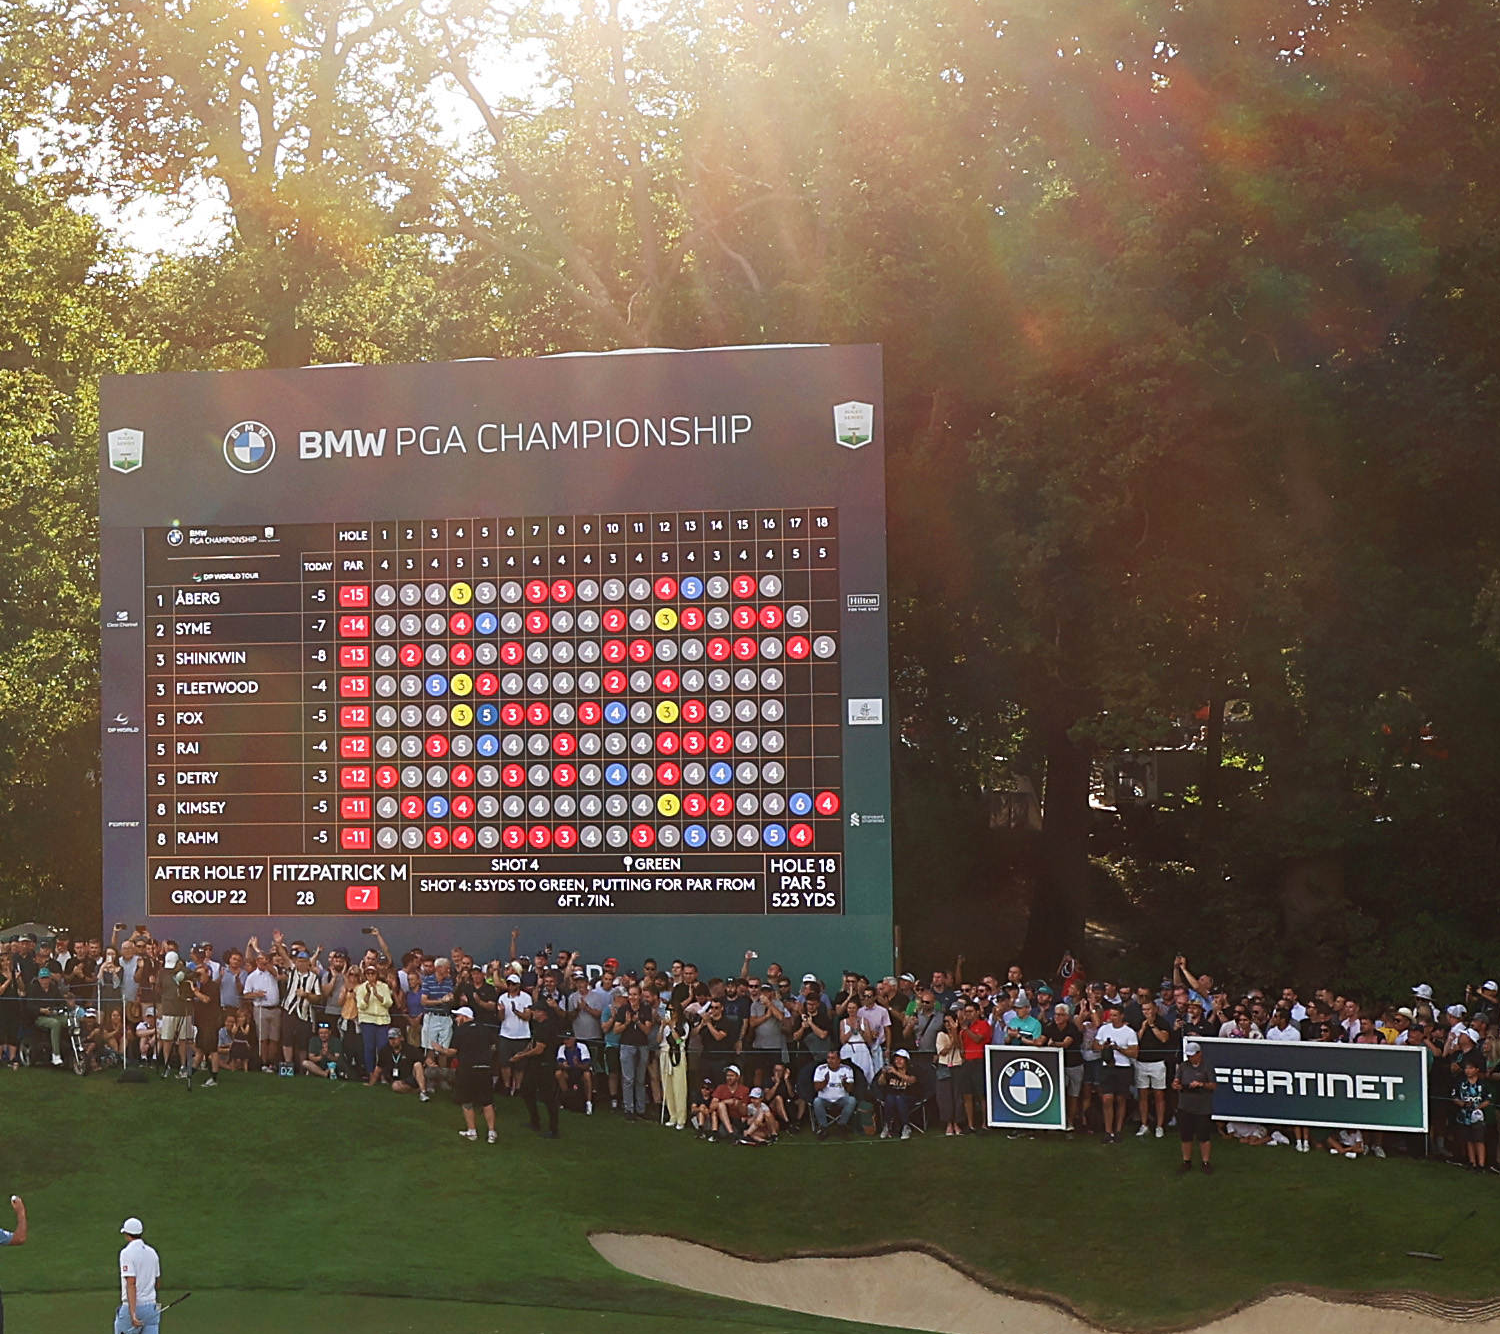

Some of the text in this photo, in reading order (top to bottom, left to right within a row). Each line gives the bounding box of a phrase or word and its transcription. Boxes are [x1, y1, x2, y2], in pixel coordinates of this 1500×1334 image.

[231, 424, 268, 439] BMW
[300, 414, 752, 460] BMW PGA CHAMPIONSHIP
[190, 530, 209, 539] BMW
[340, 517, 828, 541] HOLE 1 2 3 4 5 6 7 8 9 10 11 12 13 14 15 16 17 18
[304, 548, 826, 571] TODAY PAR 4 3 4 5 3 4 4 4 4 3 4 5 4 3 4 4 5 5
[158, 589, 363, 606] 1 ÅBERG -5 -15
[157, 619, 364, 636] 2 SYME -7 -14
[157, 649, 364, 666] 3 SHINKWIN -8 -13
[157, 679, 364, 696] 3 FLEETWOOD -4 -13
[157, 709, 364, 725] 5 FOX -5 -12
[158, 740, 364, 755] 5 RAI -4 -12
[158, 770, 365, 785] 5 DETRY -3 -12
[158, 801, 364, 815] 8 KIMSEY -5 -11
[158, 831, 364, 845] 8 RAHM -5 -11
[155, 866, 263, 879] AFTER HOLE 17
[274, 864, 406, 881] FITZPATRICK M
[492, 859, 539, 871] SHOT 4
[635, 858, 682, 873] GREEN
[771, 859, 835, 873] HOLE 18
[421, 878, 755, 892] SHOT 4: 53YDS TO GREEN, PUTTING FOR PAR FROM
[781, 876, 825, 889] PAR 5
[172, 890, 246, 903] GROUP 22
[297, 891, 314, 905] 28
[355, 890, 370, 903] -7
[558, 895, 614, 906] 6FT. 7IN.
[773, 893, 835, 907] 523 YDS
[280, 1067, 293, 1075] DZ
[1005, 1061, 1046, 1078] BMW
[1214, 1067, 1404, 1101] FORTINET
